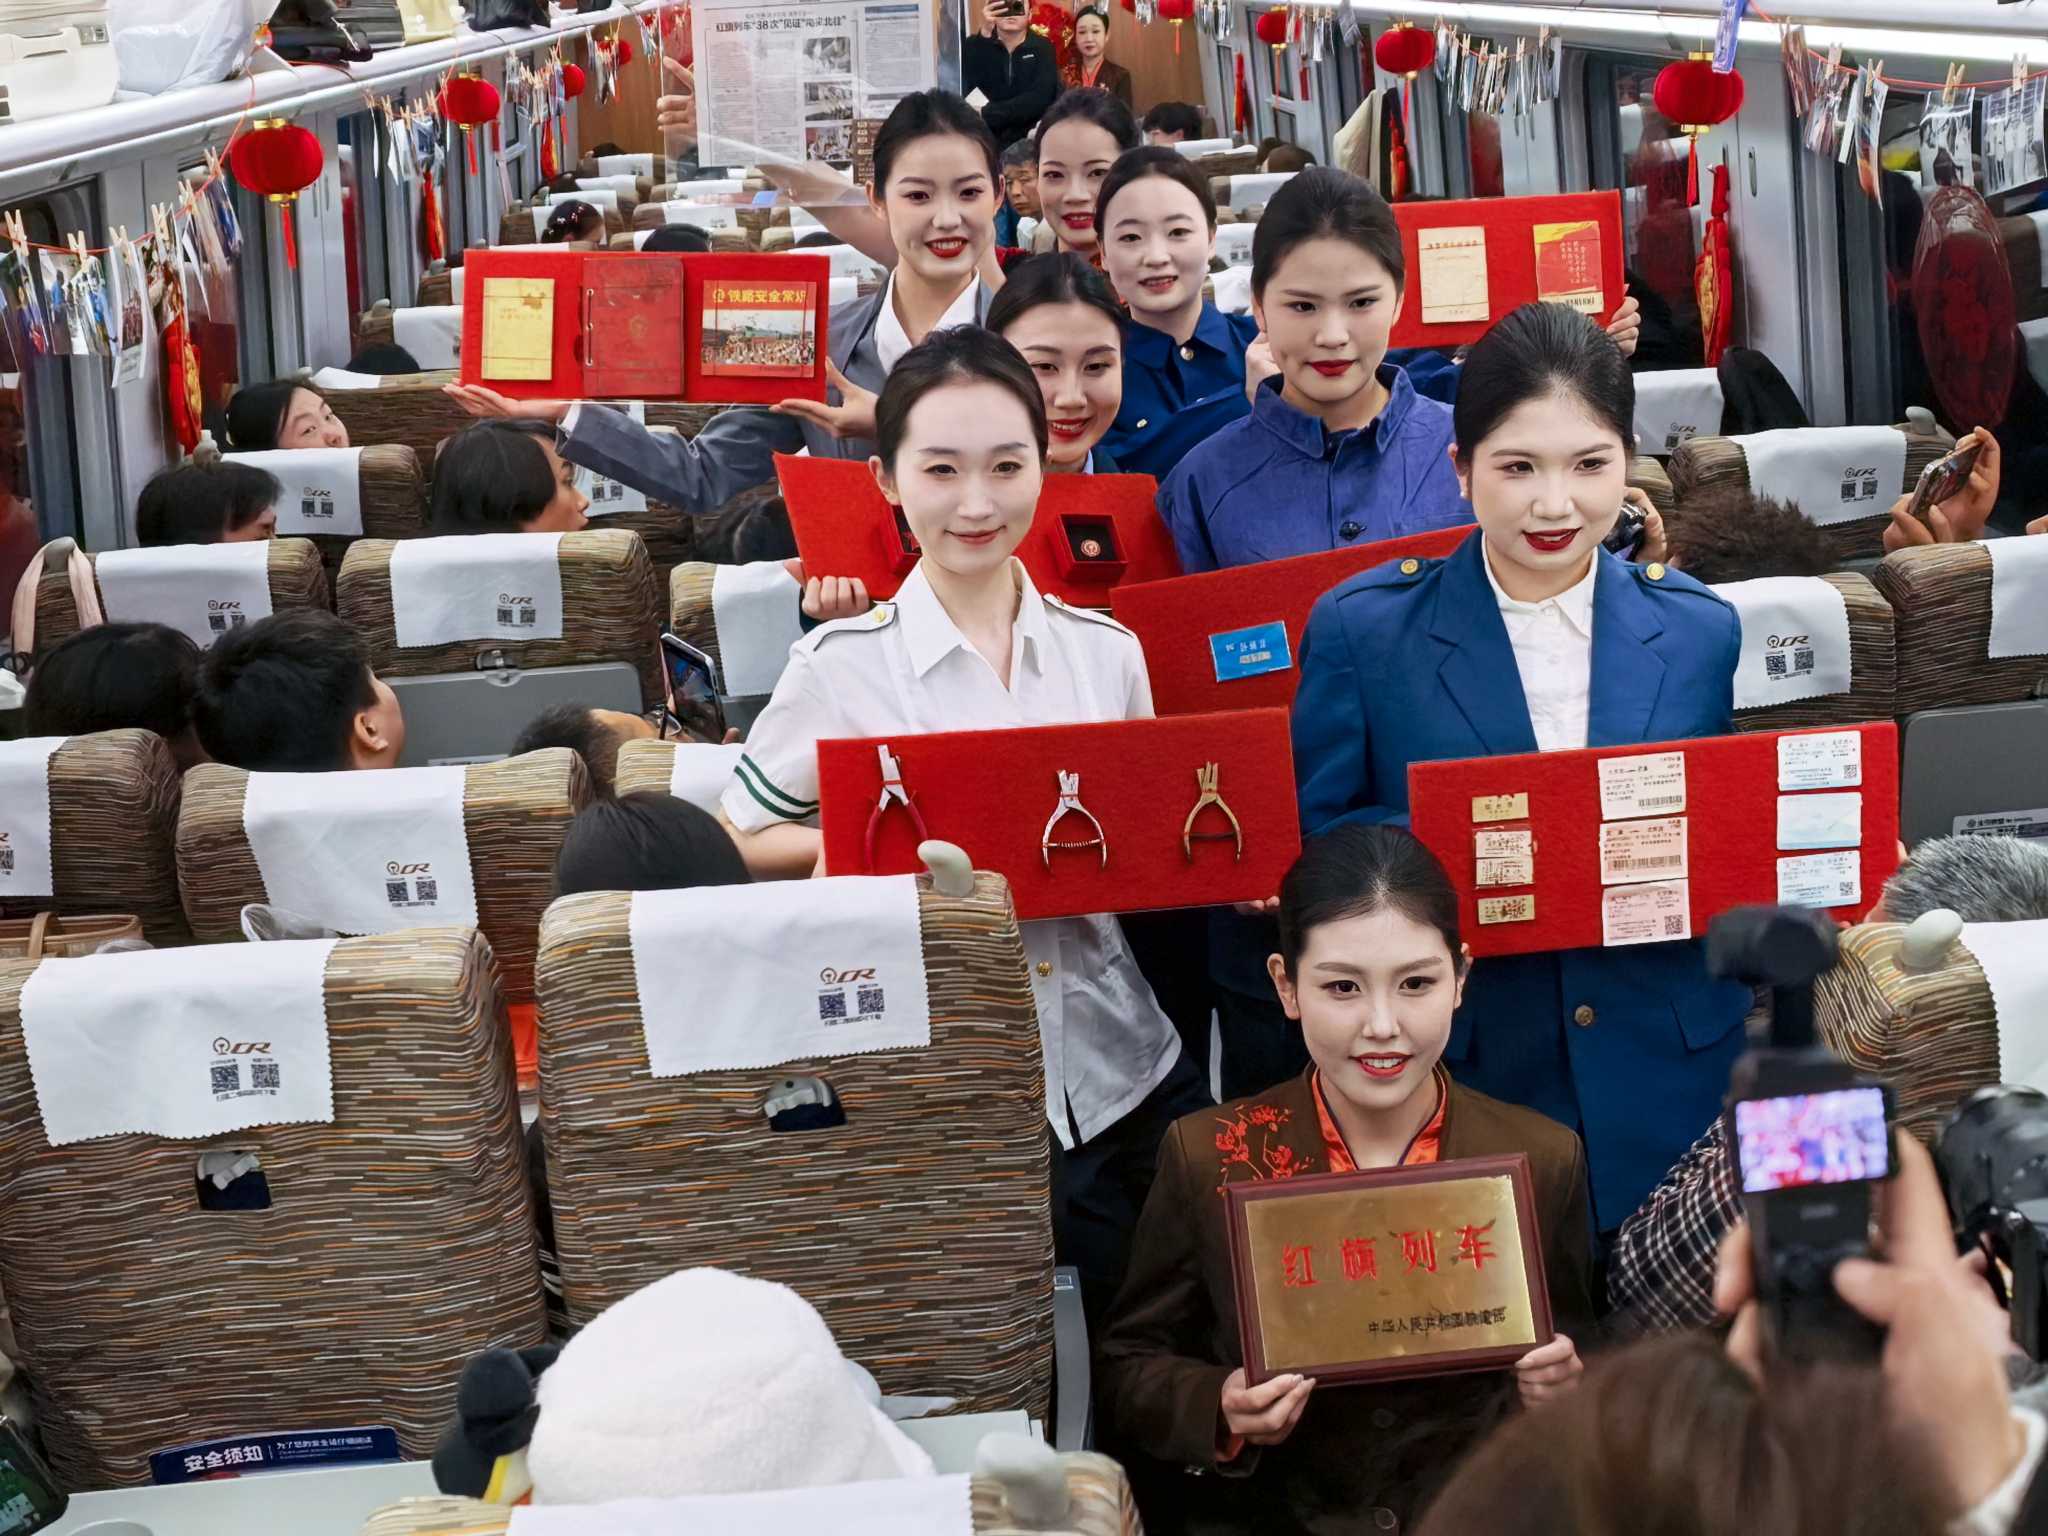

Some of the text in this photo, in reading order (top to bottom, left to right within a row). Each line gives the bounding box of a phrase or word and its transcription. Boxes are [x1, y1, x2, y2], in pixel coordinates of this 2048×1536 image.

[837, 968, 876, 983] CR
[230, 1042, 271, 1054] CR
[1282, 1218, 1496, 1288] 红旗列车
[184, 1445, 264, 1473] 安全须知
